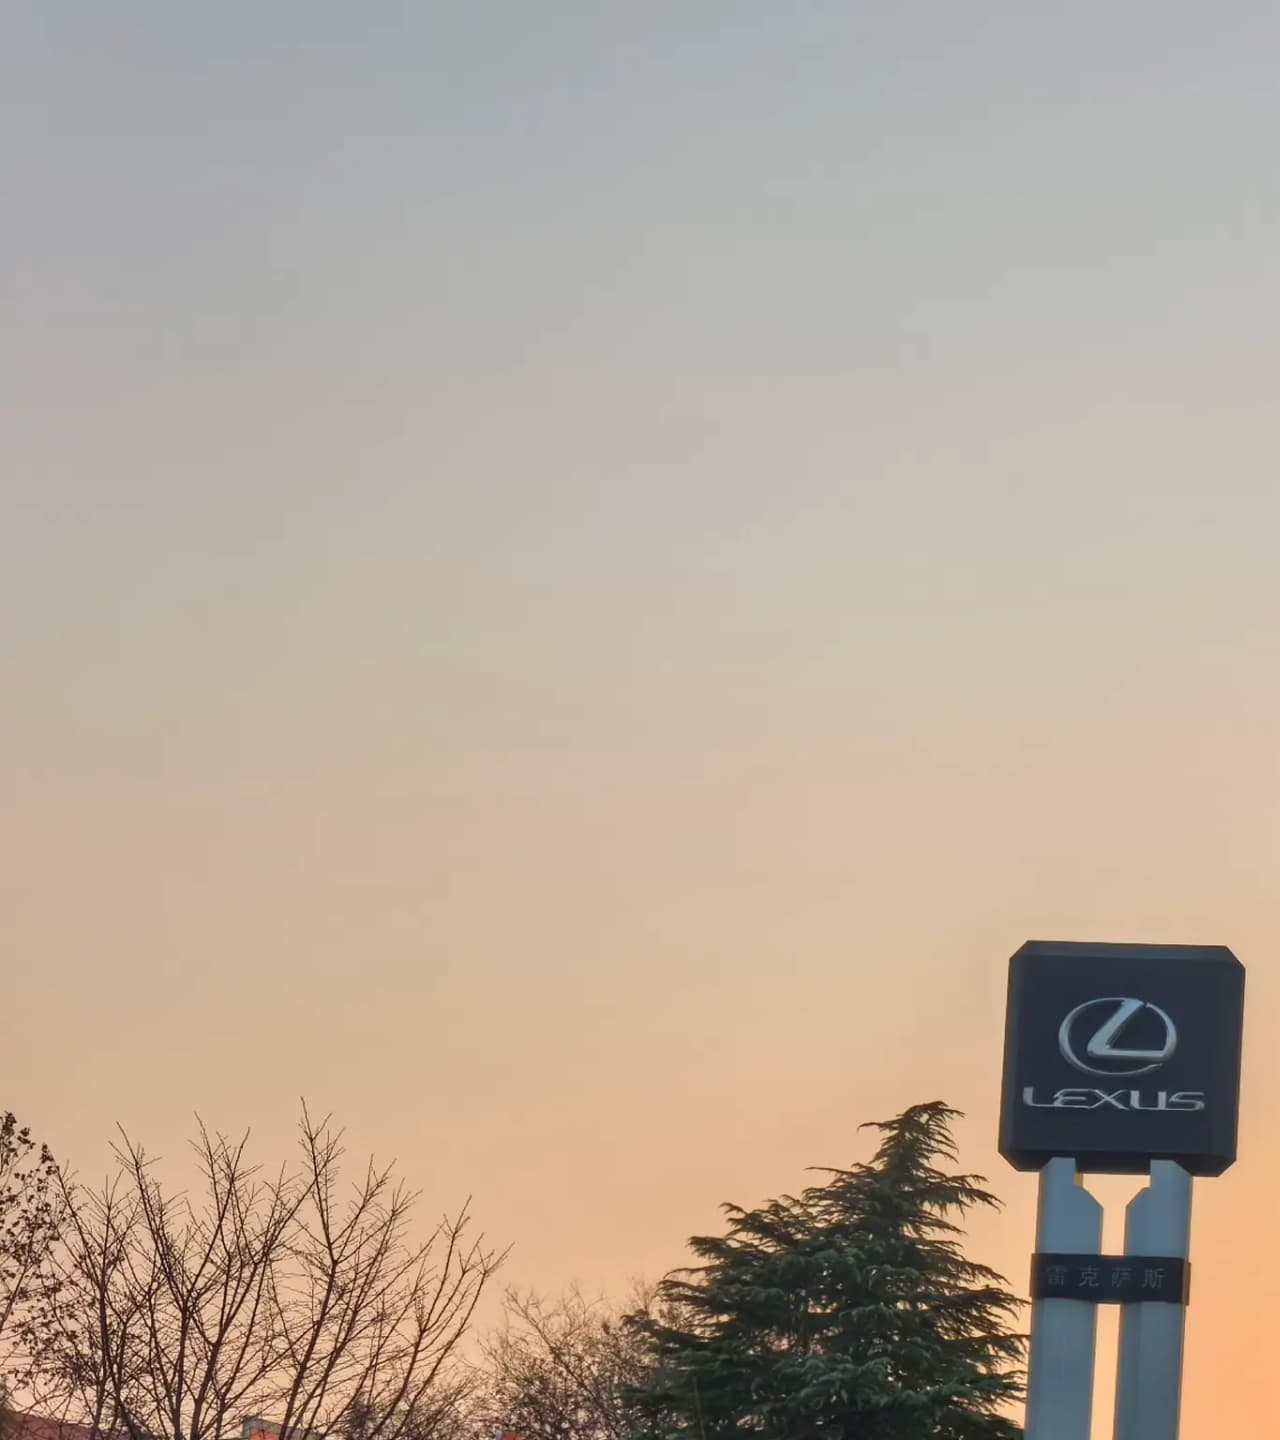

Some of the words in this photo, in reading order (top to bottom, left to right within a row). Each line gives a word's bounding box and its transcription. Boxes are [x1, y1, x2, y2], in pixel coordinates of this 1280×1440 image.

[1022, 1086, 1205, 1111] LEXUS
[1046, 1264, 1166, 1289] 雷克萨斯
